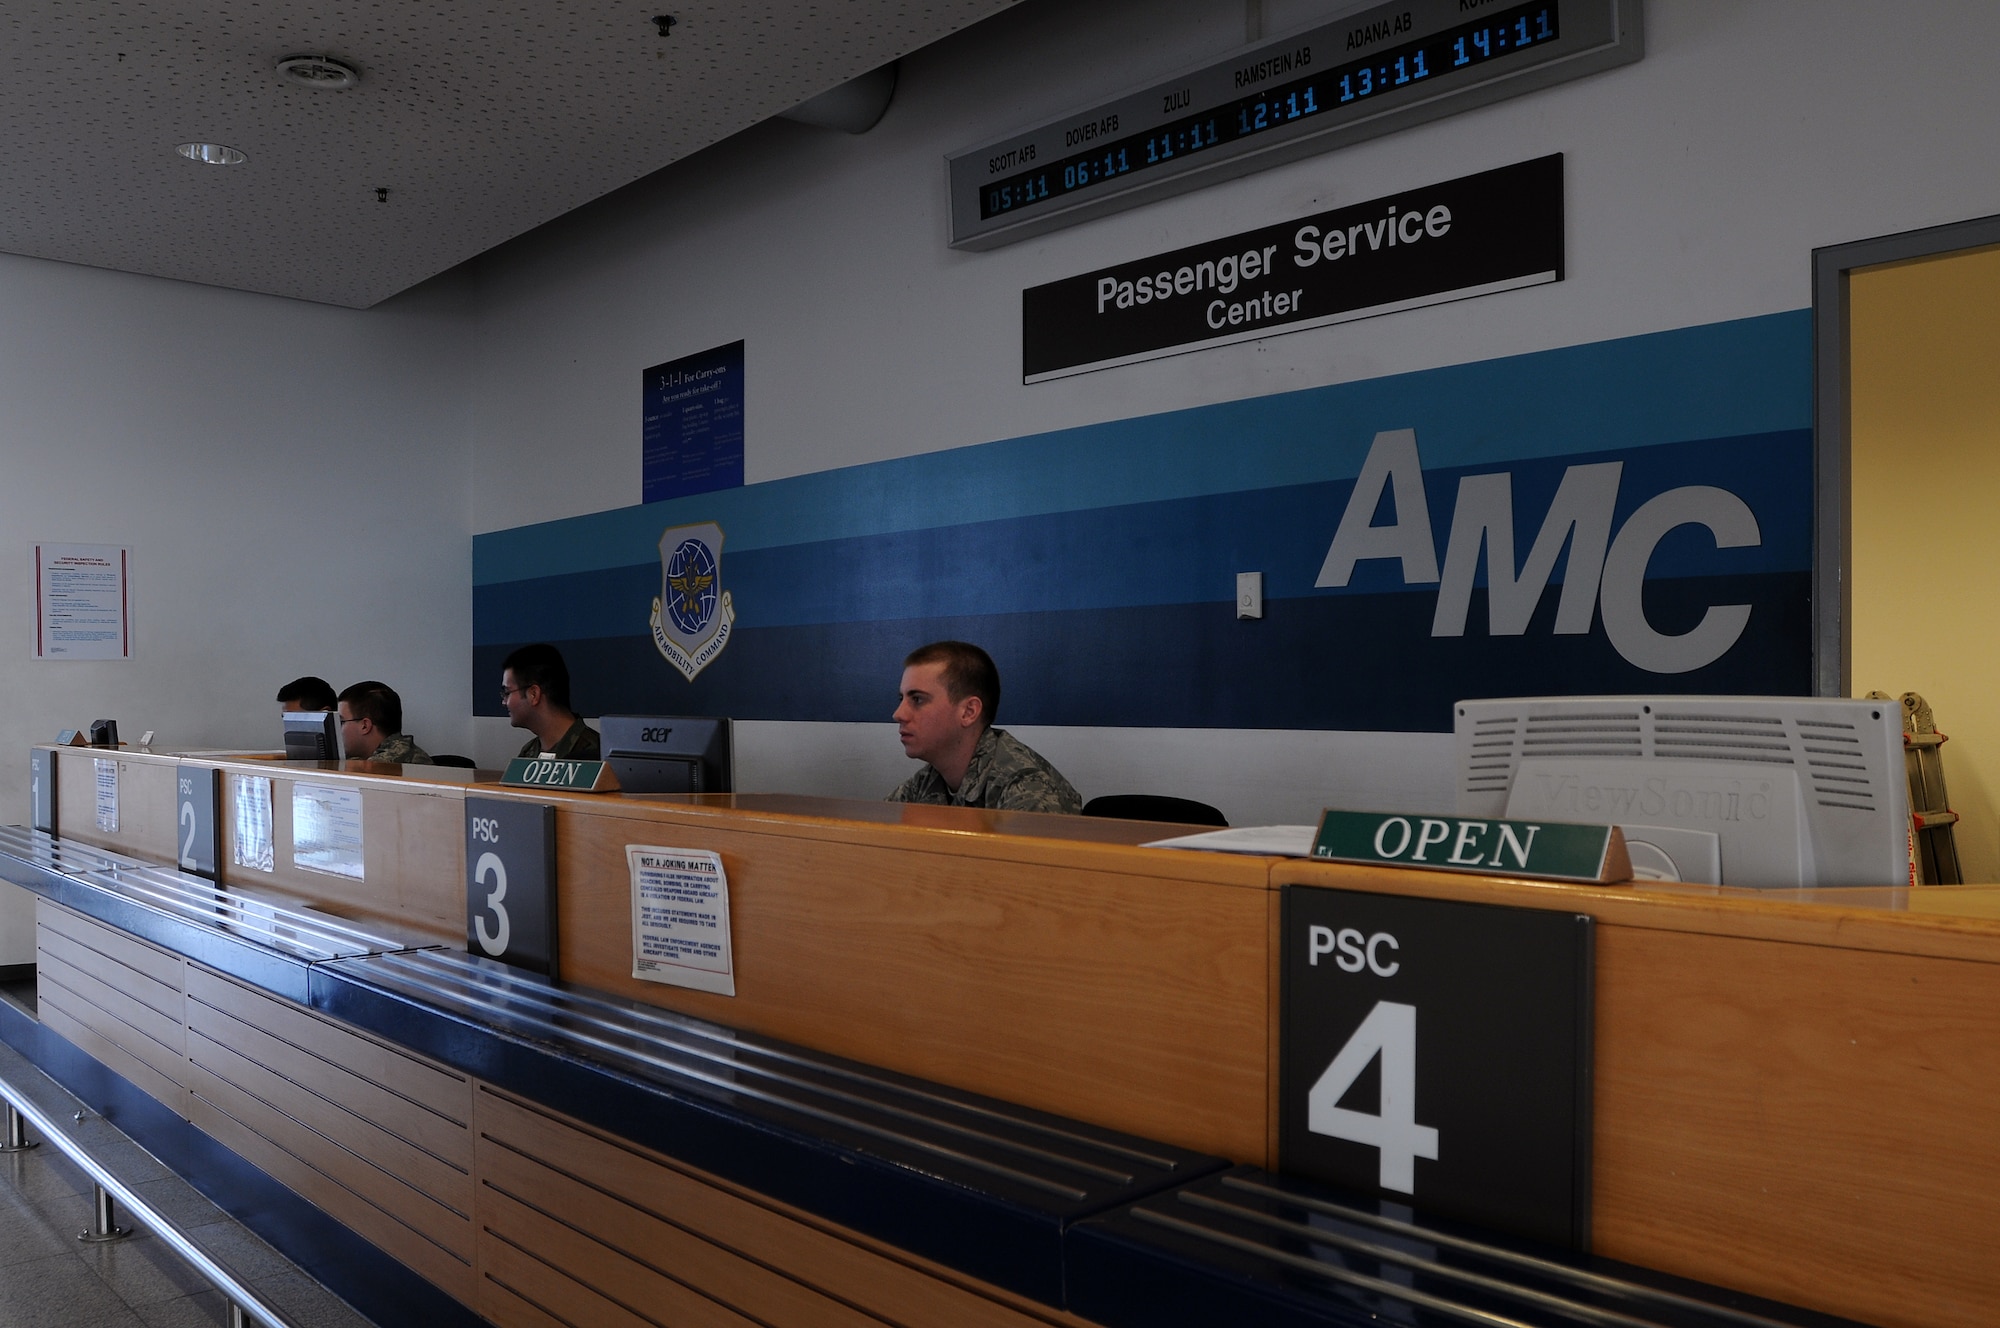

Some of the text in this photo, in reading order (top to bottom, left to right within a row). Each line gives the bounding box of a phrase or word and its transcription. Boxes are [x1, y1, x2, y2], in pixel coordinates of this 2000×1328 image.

[1346, 12, 1412, 51] ADANA AB
[1453, 8, 1554, 67] 14:11
[1234, 47, 1312, 89] RAMSTEIN AB
[1339, 49, 1429, 103] 13:11
[1163, 88, 1191, 113] ZULU
[1237, 86, 1318, 136] 12:11
[1066, 114, 1119, 147] DOVER AFB
[1146, 119, 1219, 164] 11:11
[989, 144, 1036, 174] SCOTT AFB
[1063, 148, 1130, 190] 06:11
[988, 174, 1049, 213] 05:11
[1097, 204, 1452, 314] Passenger Service
[1206, 287, 1303, 330] Center
[659, 370, 682, 391] 3-1-1
[684, 373, 695, 384] For
[1313, 427, 1762, 675] AMC
[654, 623, 728, 675] AIR MOBILITY COMMAND
[641, 725, 672, 743] acer
[180, 778, 193, 795] PSC
[522, 760, 582, 786] OPEN
[1534, 773, 1768, 821] ViewSonic
[180, 801, 197, 871] 2
[472, 816, 499, 844] PSC
[1372, 816, 1541, 870] OPEN
[641, 857, 654, 866] NOT
[662, 859, 686, 869] JOKING
[474, 851, 510, 957] 3
[672, 910, 697, 918] STATEMENTS
[642, 934, 659, 942] FEDERAL
[670, 938, 699, 947] ENFORCEMENT
[700, 942, 721, 951] AGENCIES
[1309, 924, 1400, 977] PSC
[1308, 1000, 1439, 1195] 4
